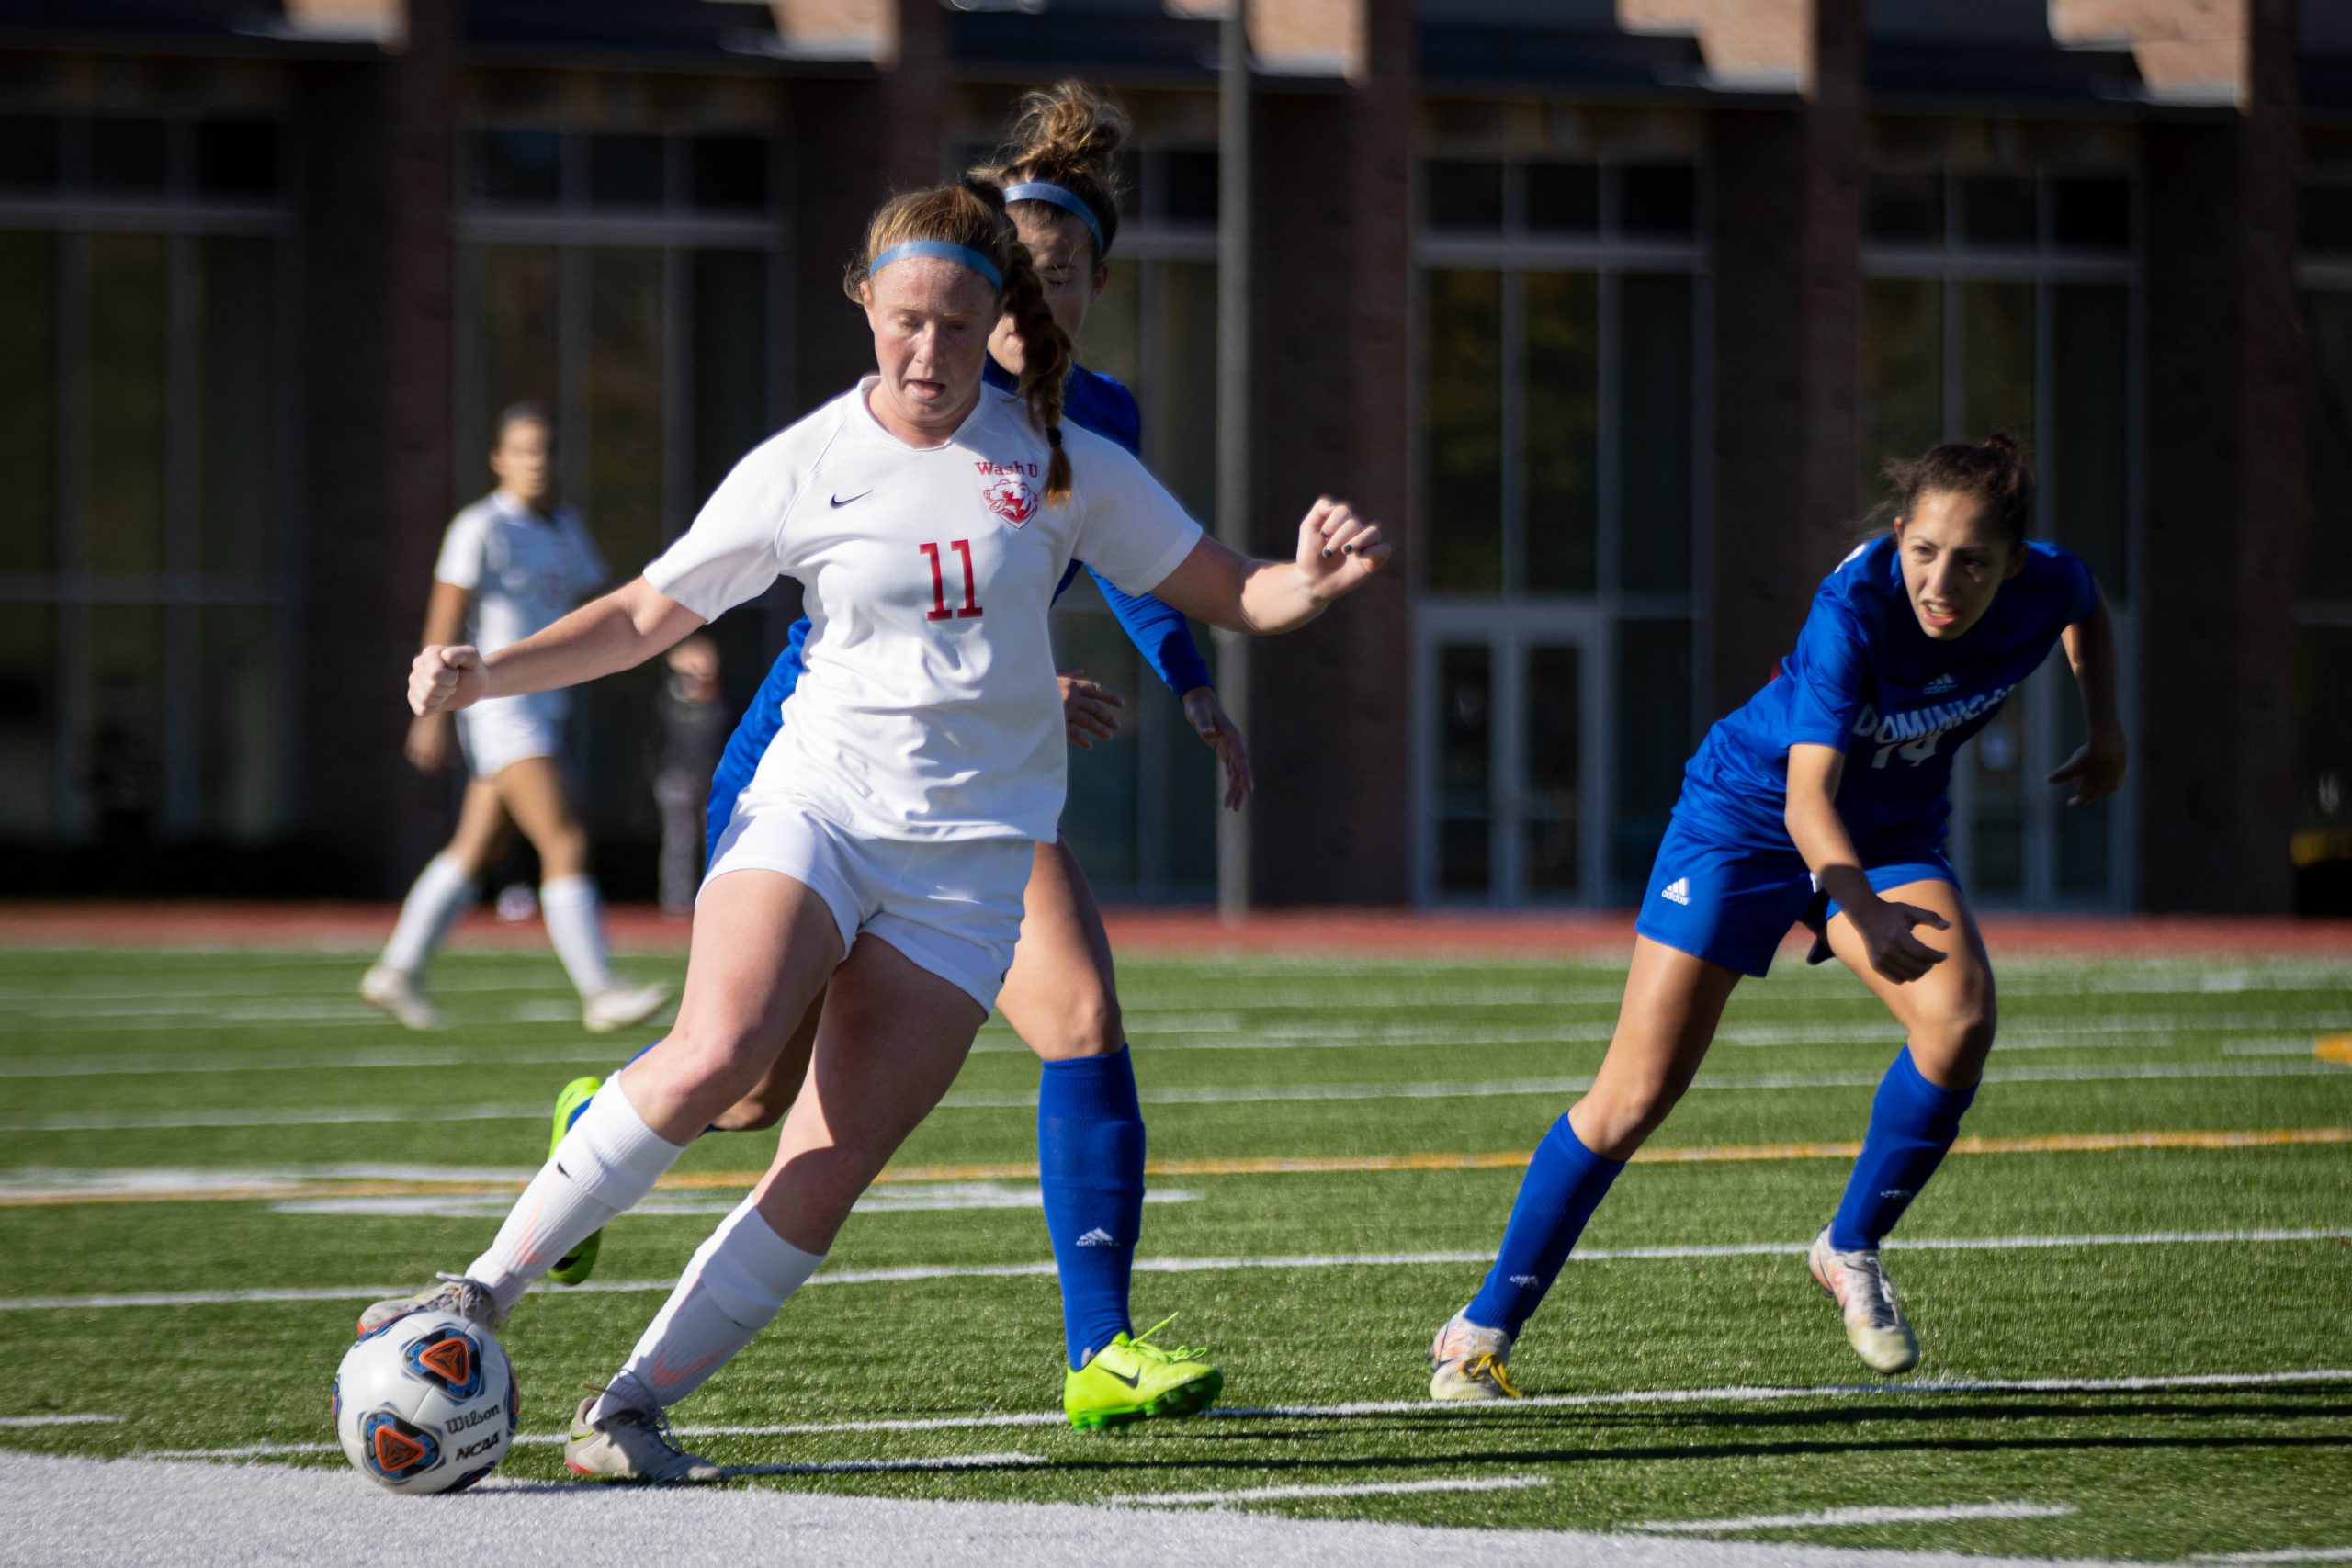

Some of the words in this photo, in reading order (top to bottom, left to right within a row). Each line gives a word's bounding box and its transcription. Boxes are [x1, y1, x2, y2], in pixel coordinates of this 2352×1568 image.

[974, 461, 1025, 476] Wash
[1027, 463, 1038, 478] U
[919, 538, 983, 621] 11
[445, 1404, 501, 1435] Wilson
[455, 1432, 501, 1462] NCAA
